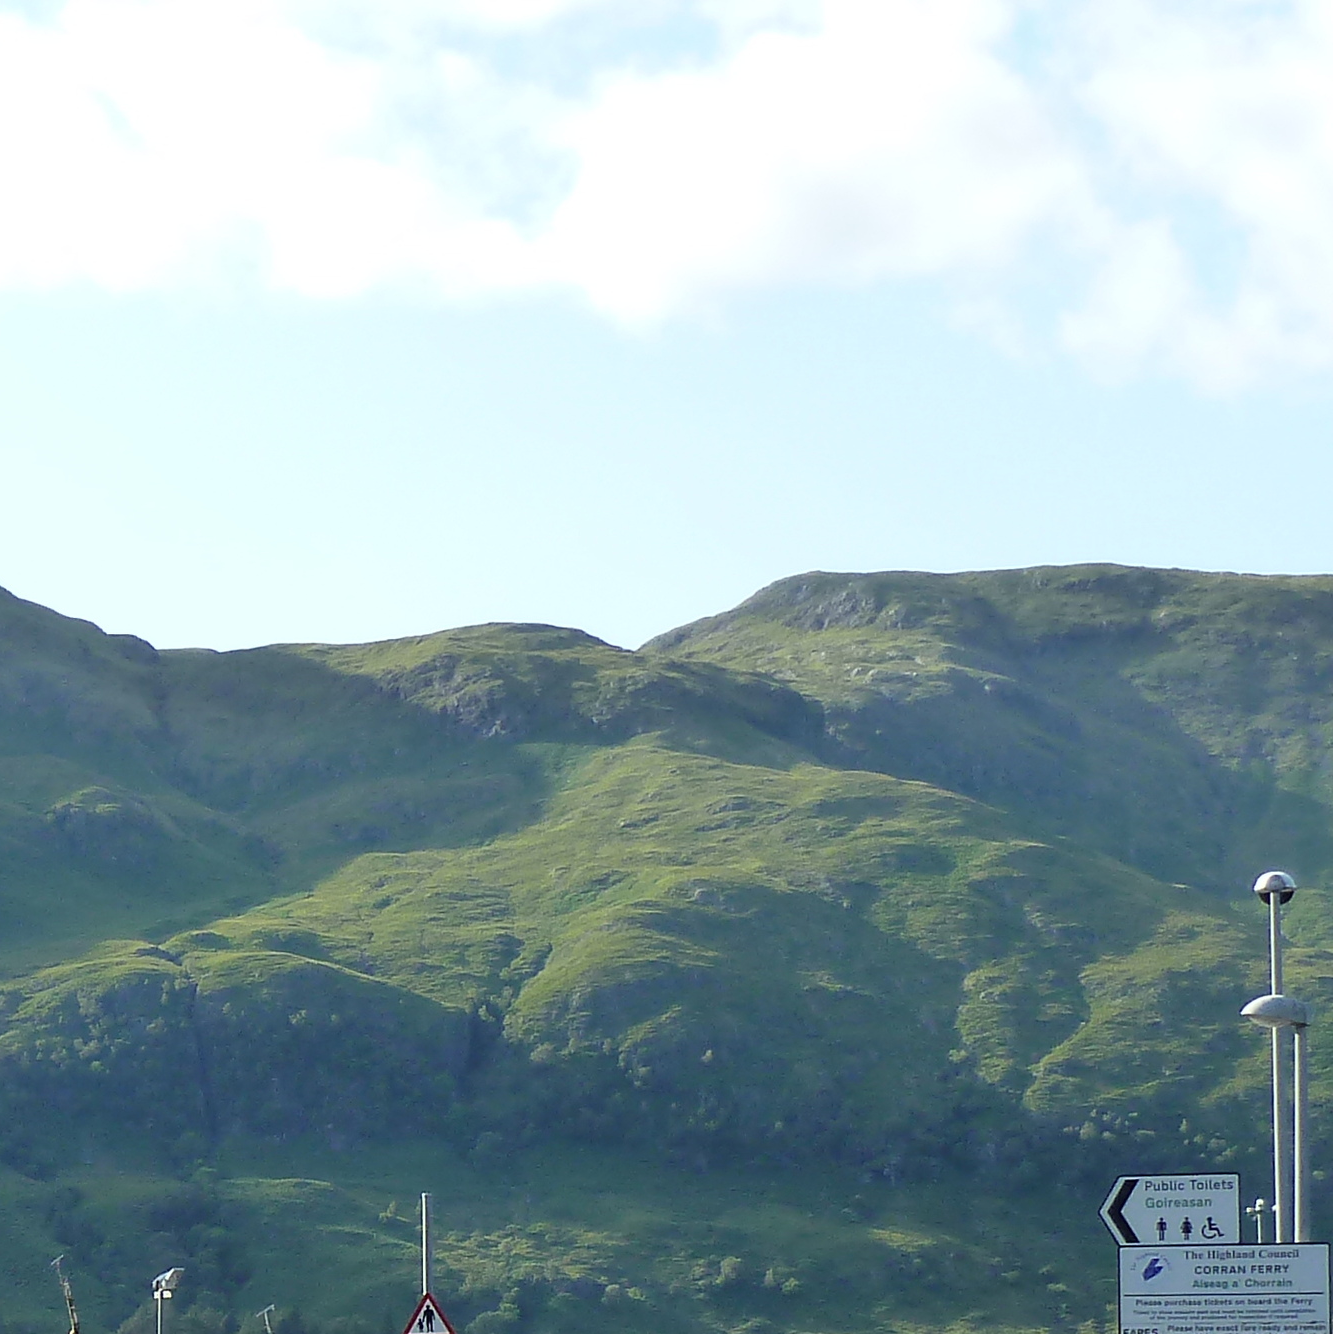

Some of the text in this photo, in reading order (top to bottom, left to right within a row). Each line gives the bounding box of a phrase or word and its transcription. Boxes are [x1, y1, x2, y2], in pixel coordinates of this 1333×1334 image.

[1145, 1180, 1234, 1191] Public Toilets
[1145, 1198, 1212, 1208] Goireasan
[1184, 1249, 1299, 1261] The Highland Council
[1194, 1264, 1290, 1275] CORRAN FERRY
[1192, 1279, 1228, 1289] Aiseag
[1245, 1278, 1293, 1288] Chorrain
[1164, 1299, 1201, 1307] purchase
[1204, 1298, 1232, 1306] tickets
[1258, 1324, 1280, 1332] ready
